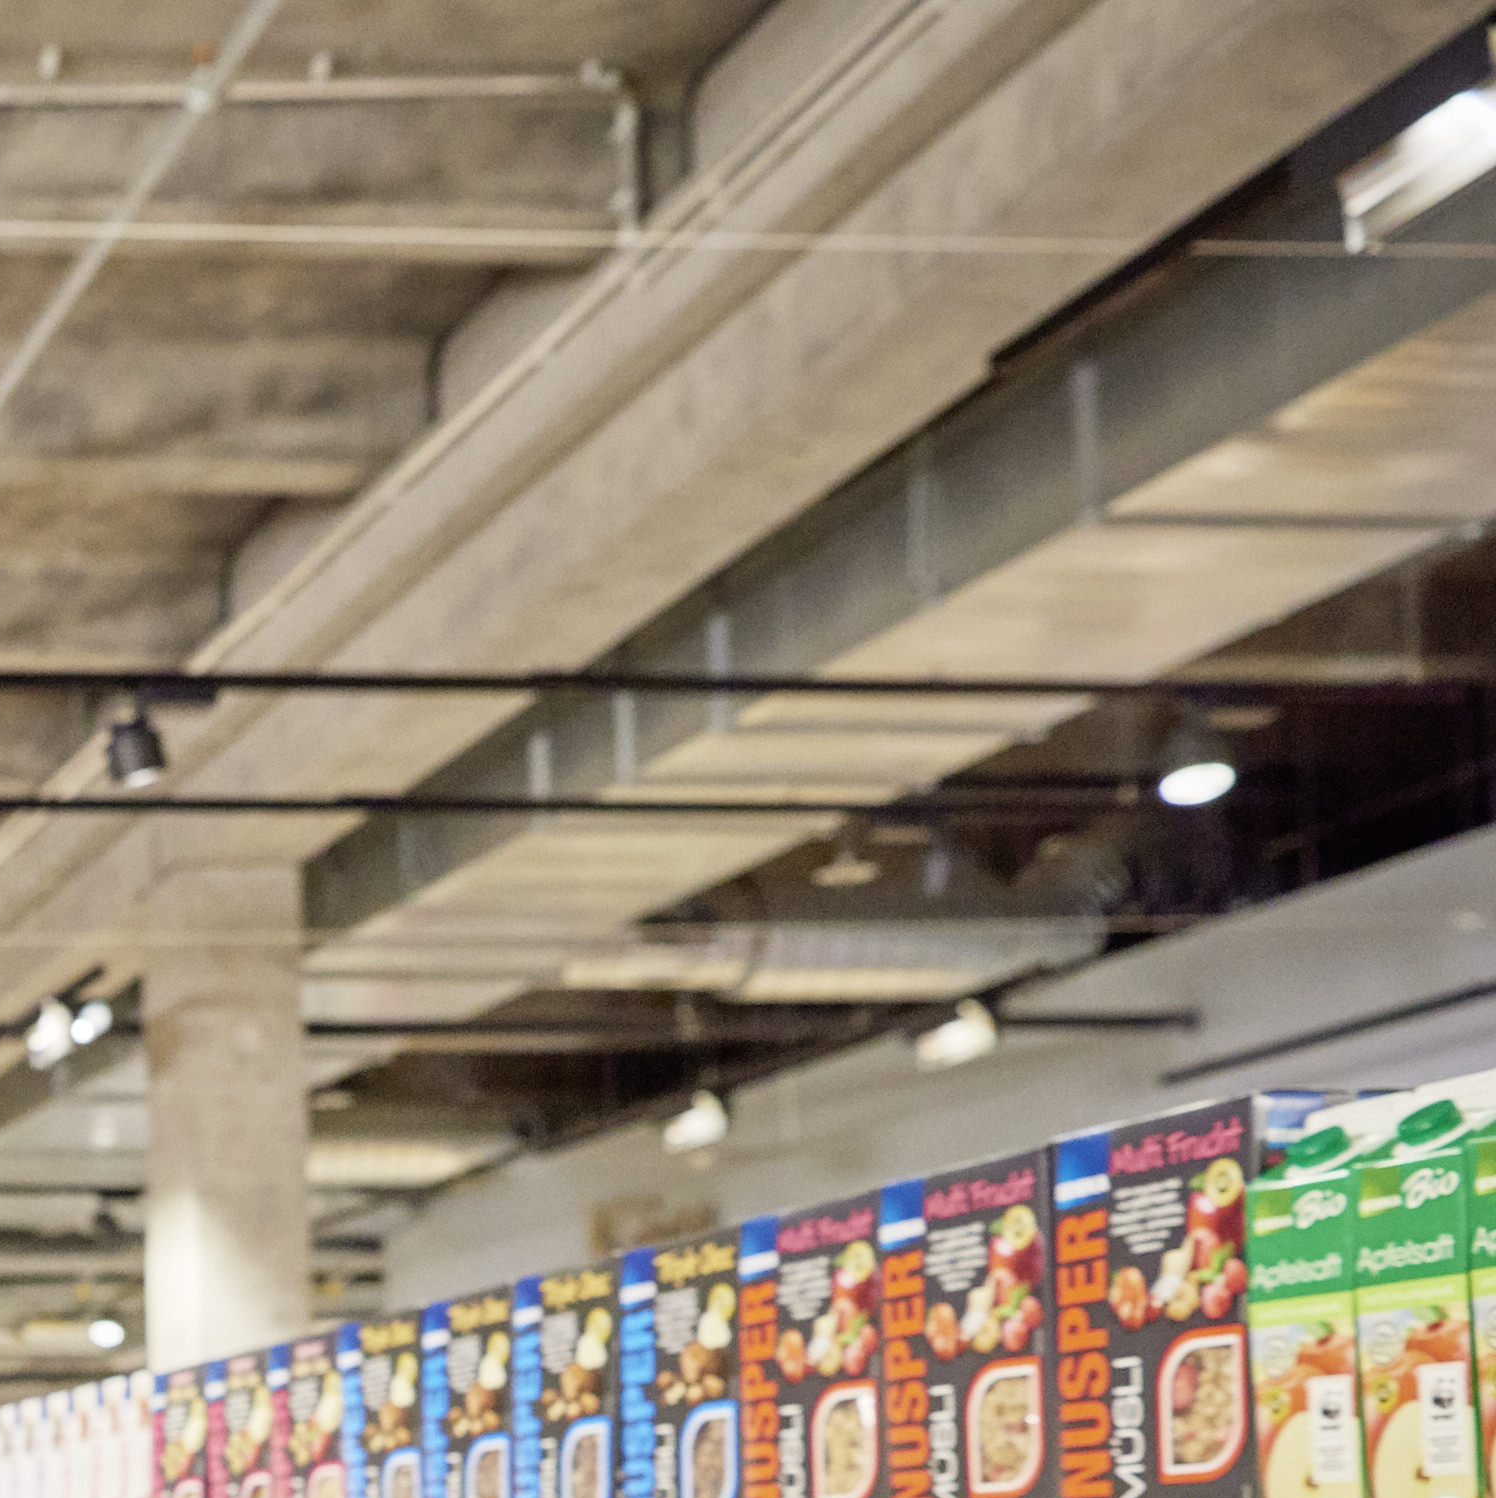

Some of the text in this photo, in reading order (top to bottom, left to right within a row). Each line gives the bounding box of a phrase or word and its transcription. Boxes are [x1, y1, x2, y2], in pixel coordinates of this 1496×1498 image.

[1292, 1188, 1348, 1229] Bio
[1401, 1167, 1460, 1210] Bio
[1357, 1233, 1455, 1276] Apfelsaft
